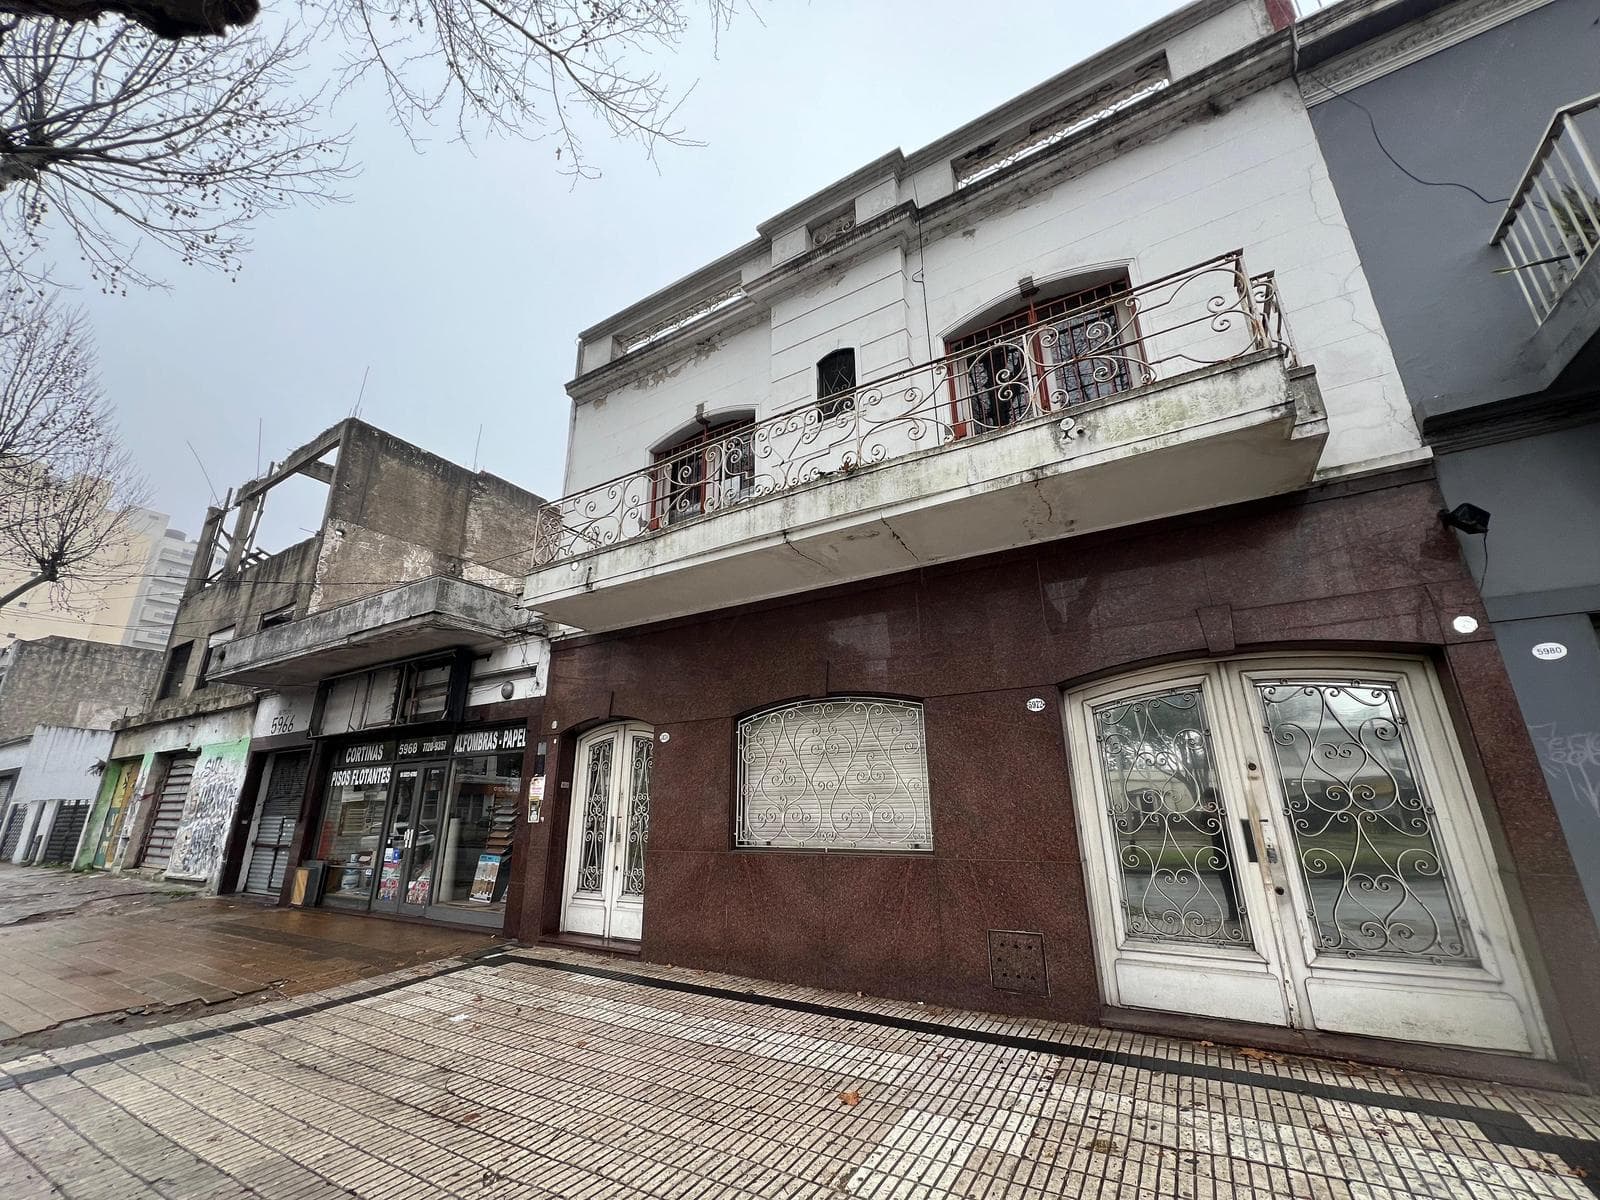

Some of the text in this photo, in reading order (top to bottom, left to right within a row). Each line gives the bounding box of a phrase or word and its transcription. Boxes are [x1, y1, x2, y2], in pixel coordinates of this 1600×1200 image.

[1536, 646, 1562, 656] 5980
[271, 714, 296, 734] 5966
[398, 742, 418, 755] 5968
[453, 731, 498, 753] ALFOMBRAS
[502, 727, 527, 749] PAPEL
[345, 744, 385, 763] CORTINAS
[330, 766, 392, 787] PISOS FLOTANTES
